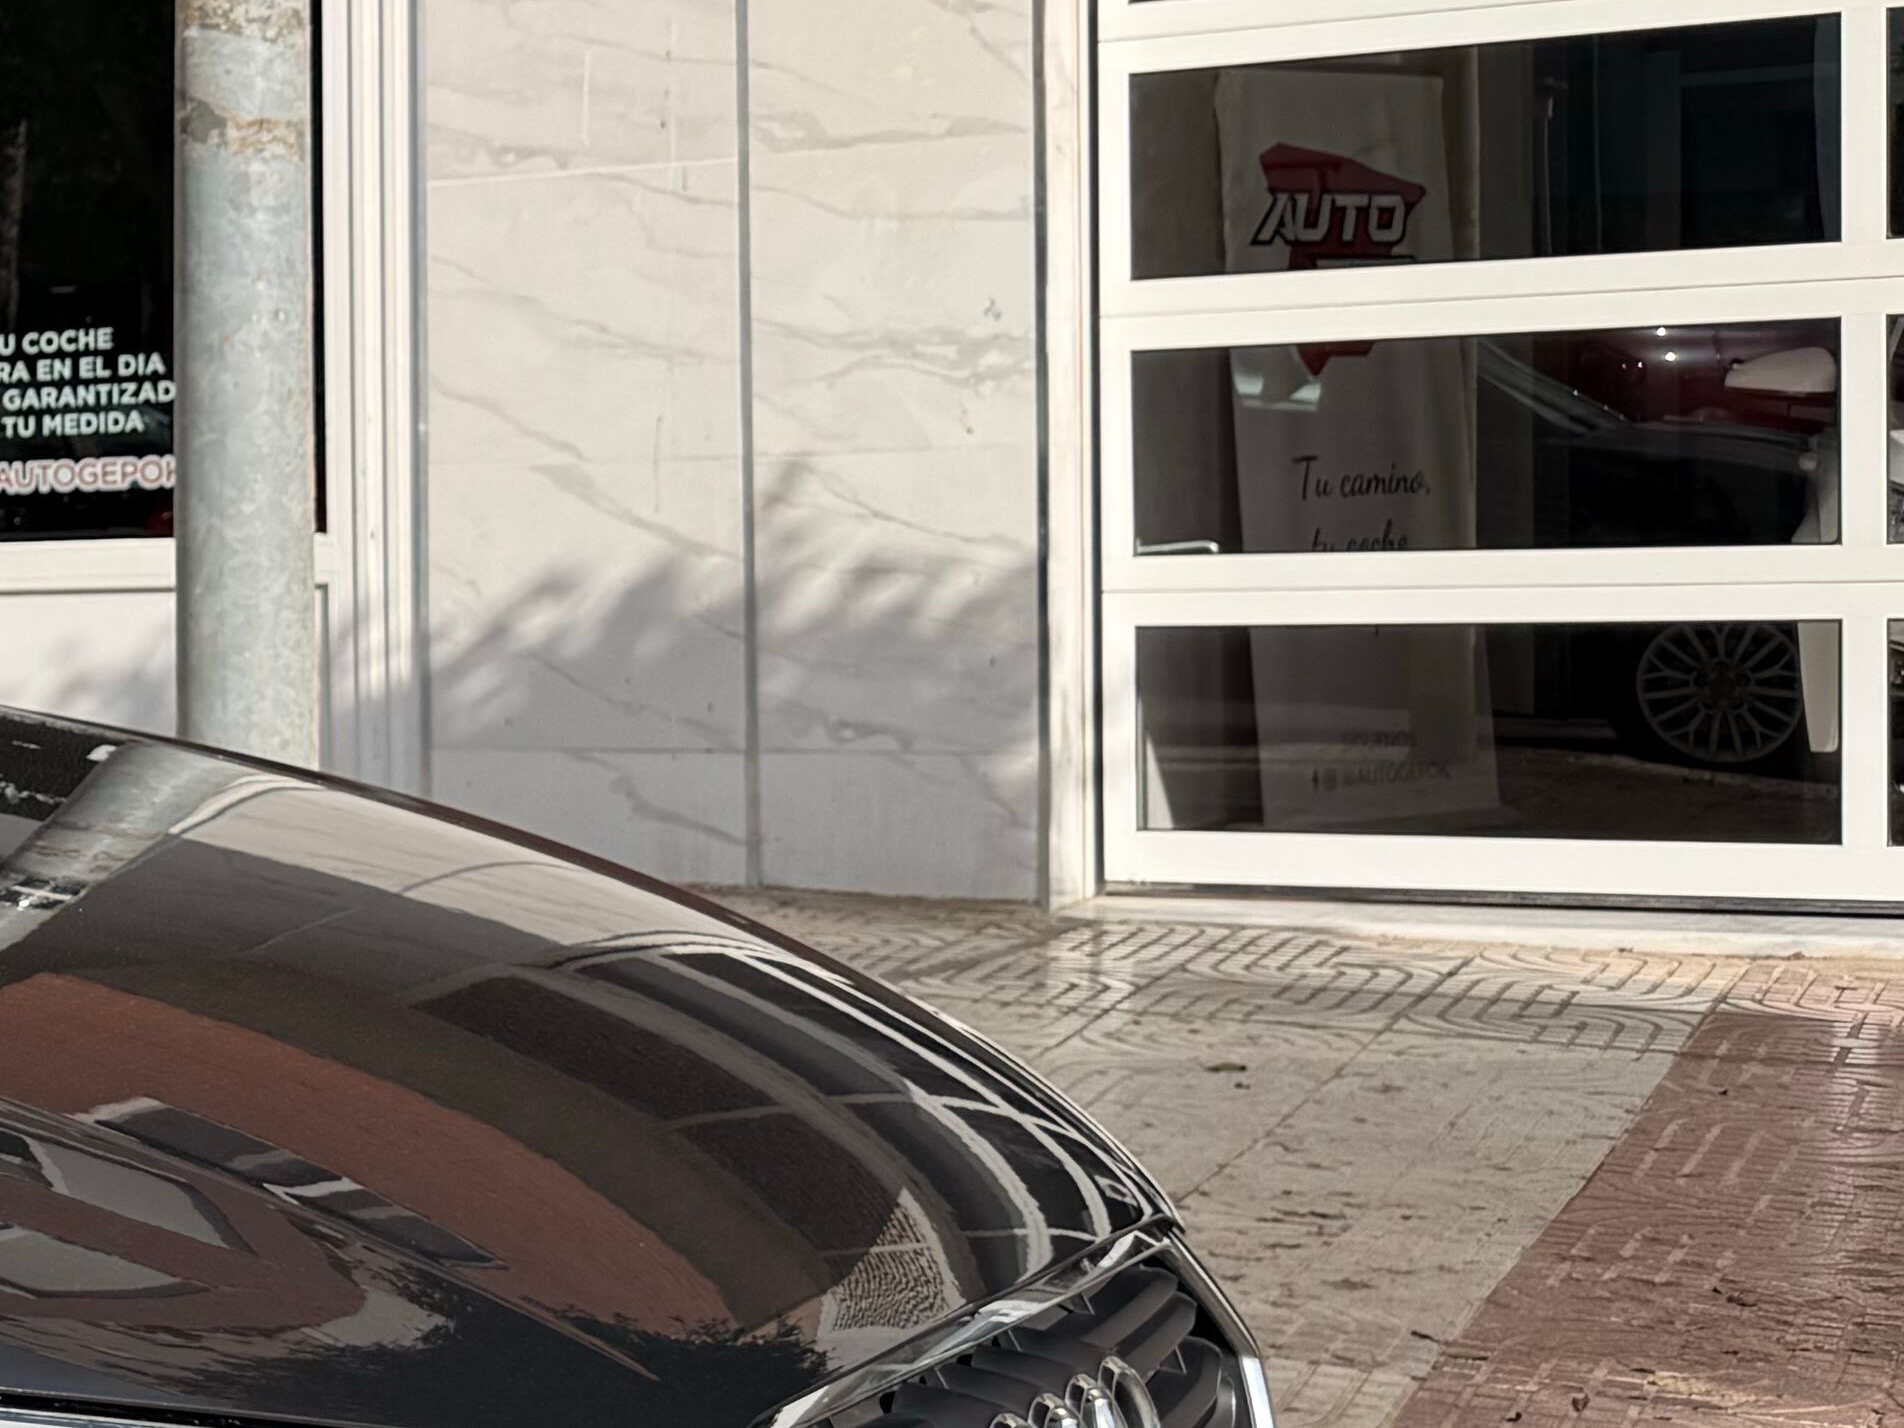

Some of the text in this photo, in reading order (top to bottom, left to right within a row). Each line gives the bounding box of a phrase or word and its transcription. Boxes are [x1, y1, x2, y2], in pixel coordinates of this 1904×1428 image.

[1249, 191, 1408, 247] AUTO
[21, 327, 114, 355] COCHE
[37, 358, 72, 382] EN
[78, 355, 112, 379] EL
[117, 352, 166, 377] DIA
[0, 414, 36, 439] TU
[42, 409, 145, 438] MEDIDA
[1292, 453, 1431, 501] Tu camino,
